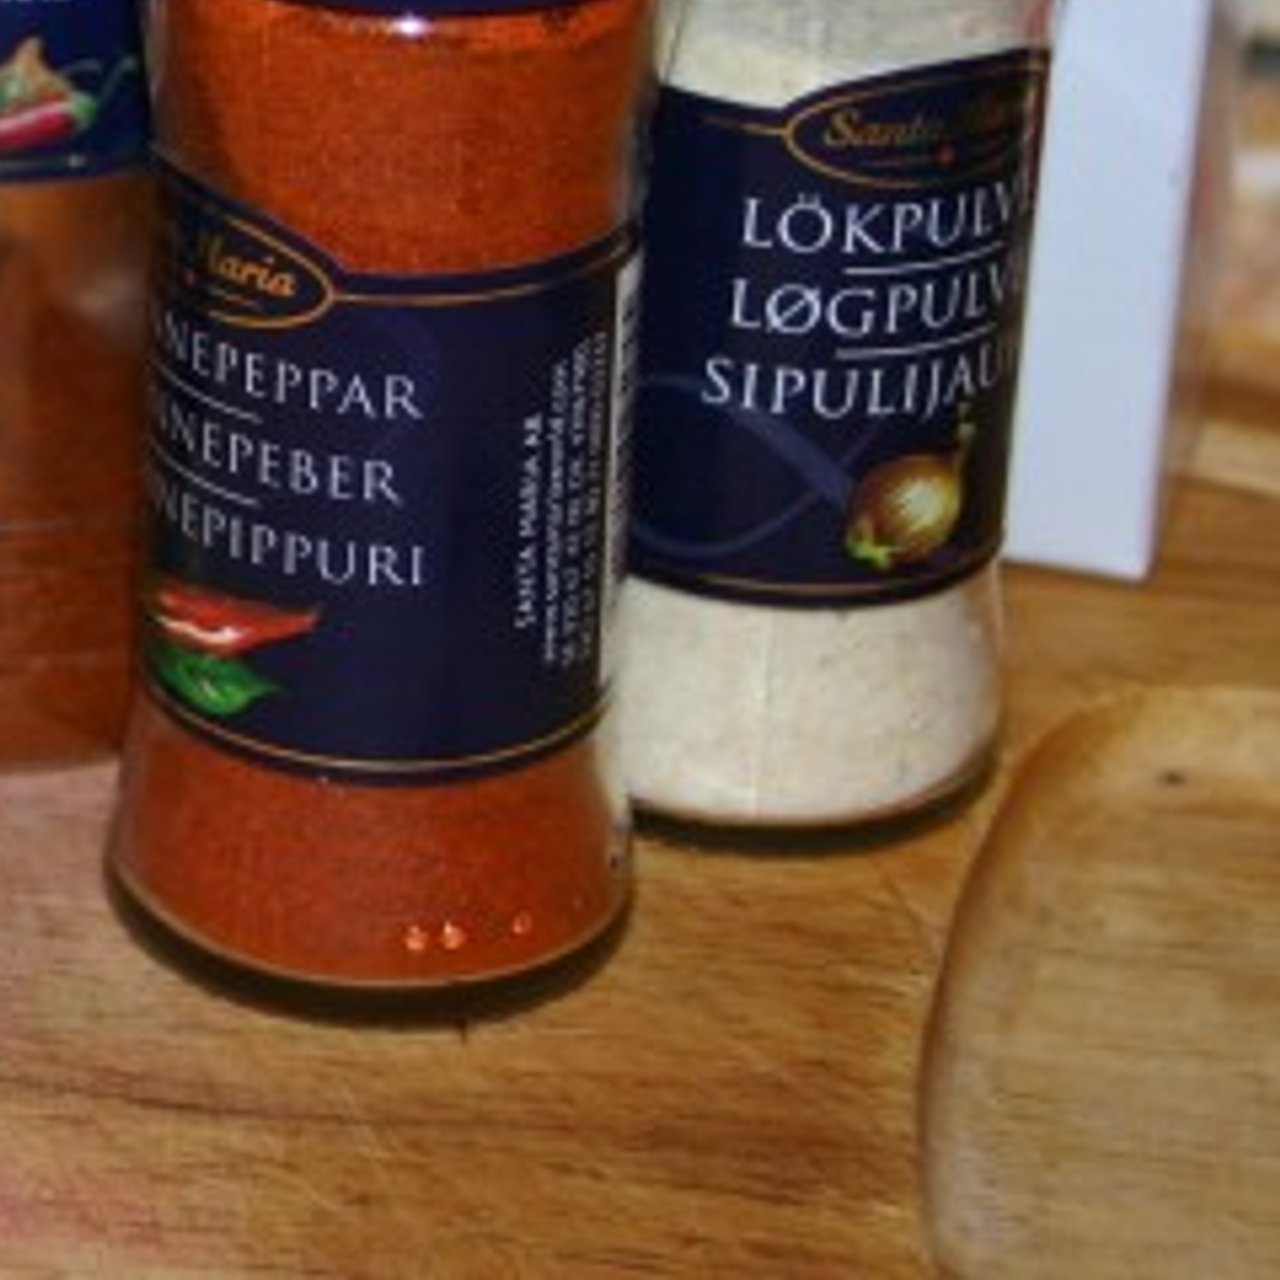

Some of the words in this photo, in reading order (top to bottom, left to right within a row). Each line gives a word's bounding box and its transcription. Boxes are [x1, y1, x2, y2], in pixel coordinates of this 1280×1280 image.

[741, 181, 1016, 254] LÖKPULV
[730, 261, 1010, 338] LØGPULV
[701, 350, 1002, 420] SIPULIJAU
